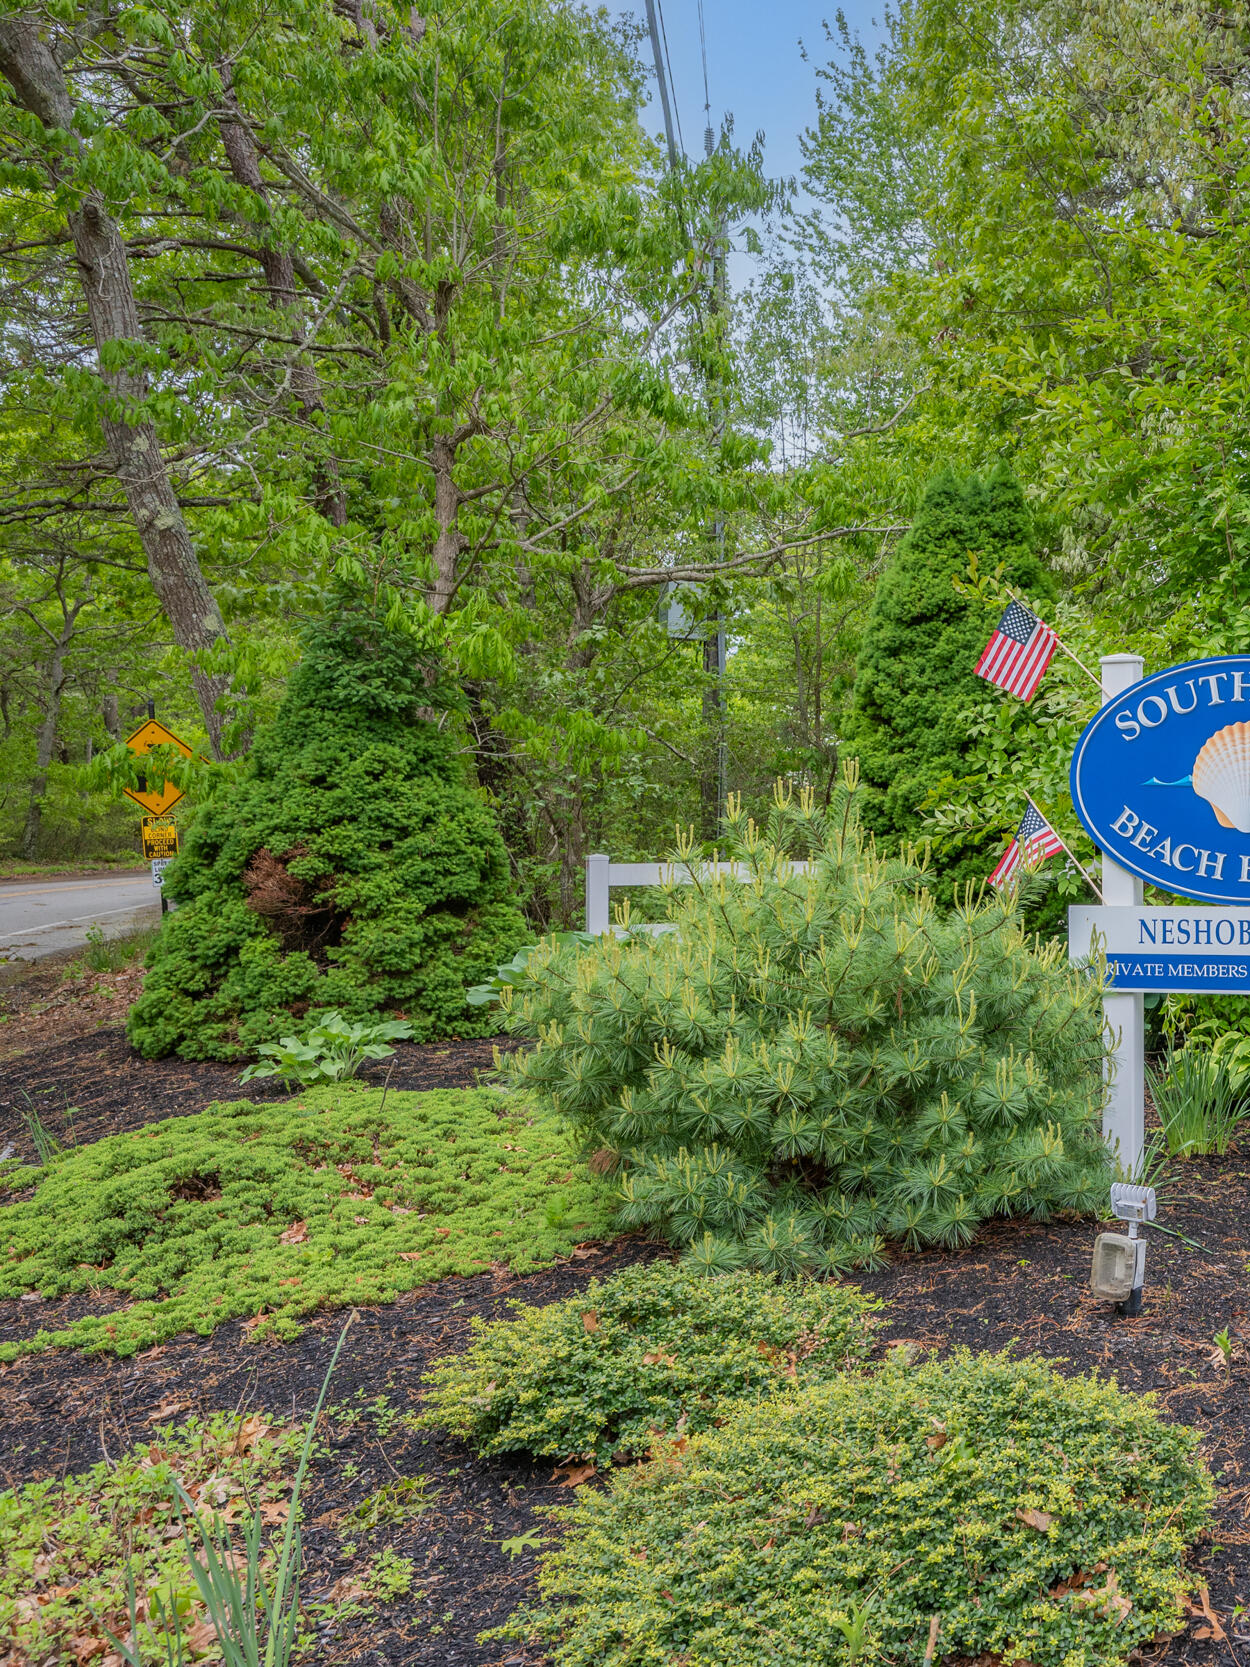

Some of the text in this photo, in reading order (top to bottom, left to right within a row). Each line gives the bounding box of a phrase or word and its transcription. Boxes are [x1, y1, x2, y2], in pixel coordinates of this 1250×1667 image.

[1109, 805, 1228, 882] BEACH
[154, 874, 163, 884] 3
[1104, 962, 1164, 977] RIVATE
[1167, 964, 1248, 979] MEMBERS
